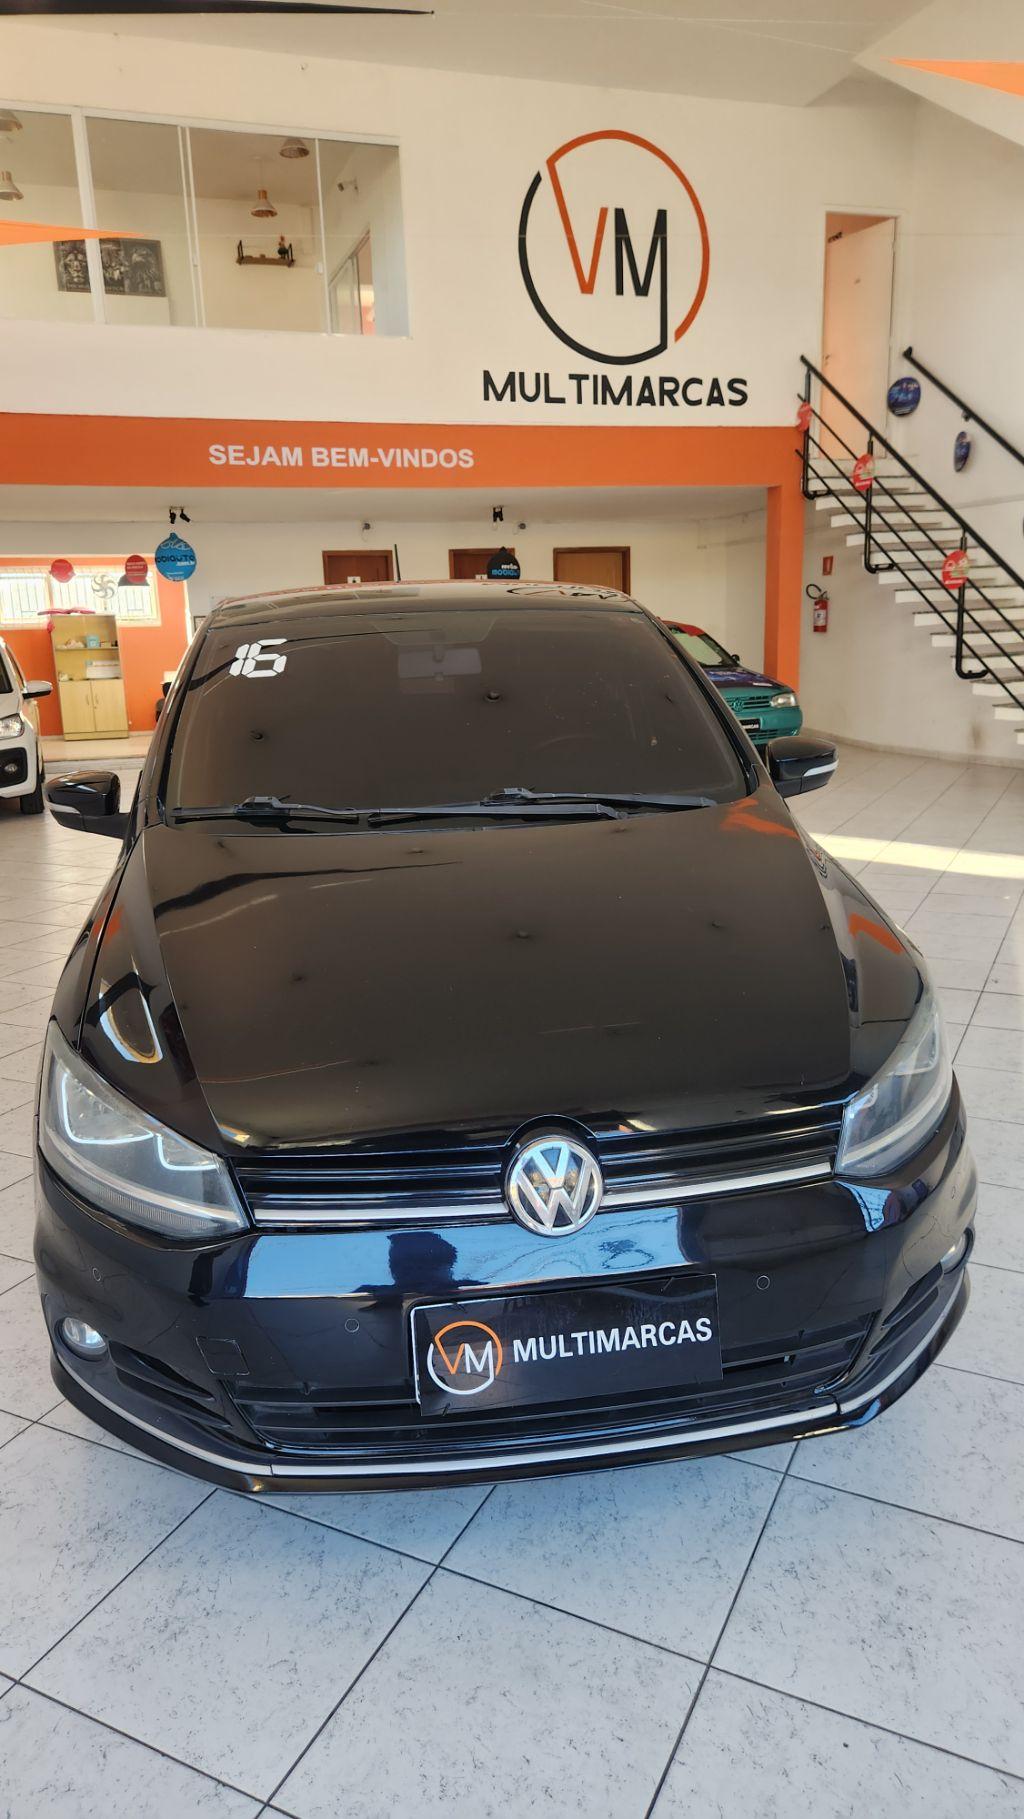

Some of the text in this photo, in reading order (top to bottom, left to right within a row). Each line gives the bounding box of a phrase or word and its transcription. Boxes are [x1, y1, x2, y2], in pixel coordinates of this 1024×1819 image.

[483, 370, 748, 406] MULTIMARCAS
[208, 444, 475, 468] SEJAM BEM-VINDOS
[229, 638, 287, 678] 16
[513, 1317, 713, 1363] MULTIMARCAS
